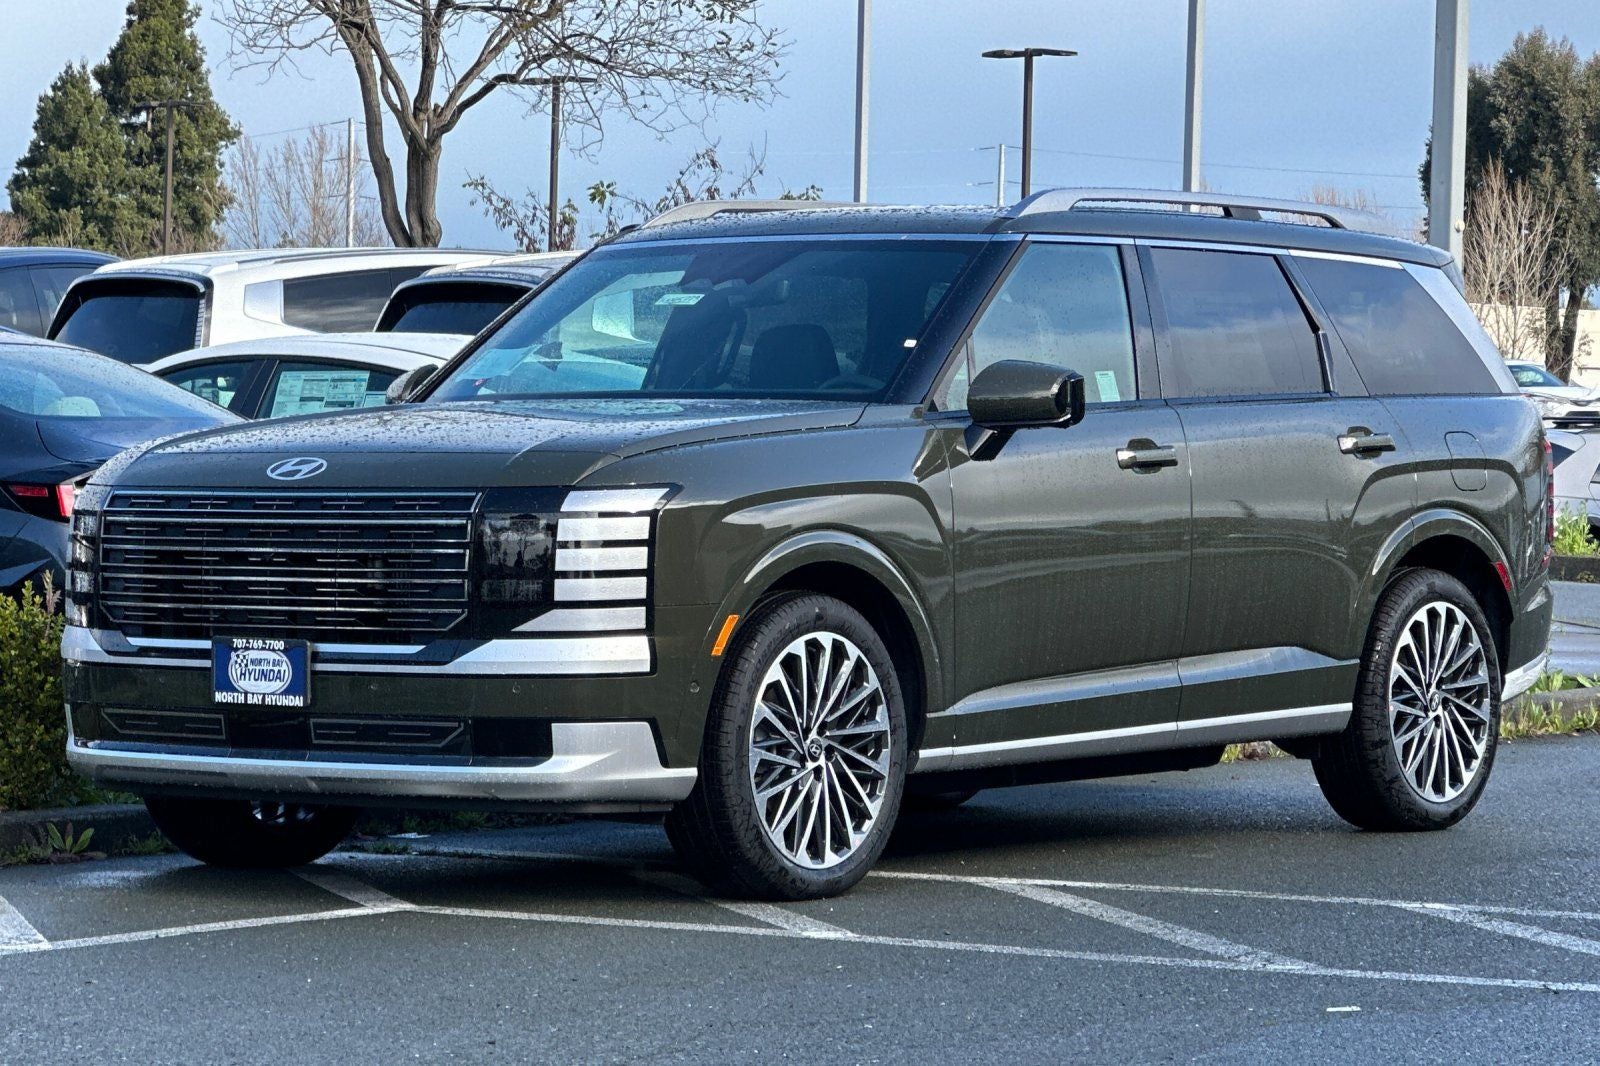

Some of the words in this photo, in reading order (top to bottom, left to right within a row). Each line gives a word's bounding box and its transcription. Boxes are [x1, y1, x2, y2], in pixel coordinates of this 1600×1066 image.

[233, 639, 285, 650] 707-769-7700
[250, 658, 271, 667] NORTH
[272, 658, 285, 667] BAY
[240, 668, 286, 683] HYUNDAI
[215, 692, 245, 704] NORTH
[247, 694, 263, 705] BAY
[265, 694, 304, 707] HYUNDAI
